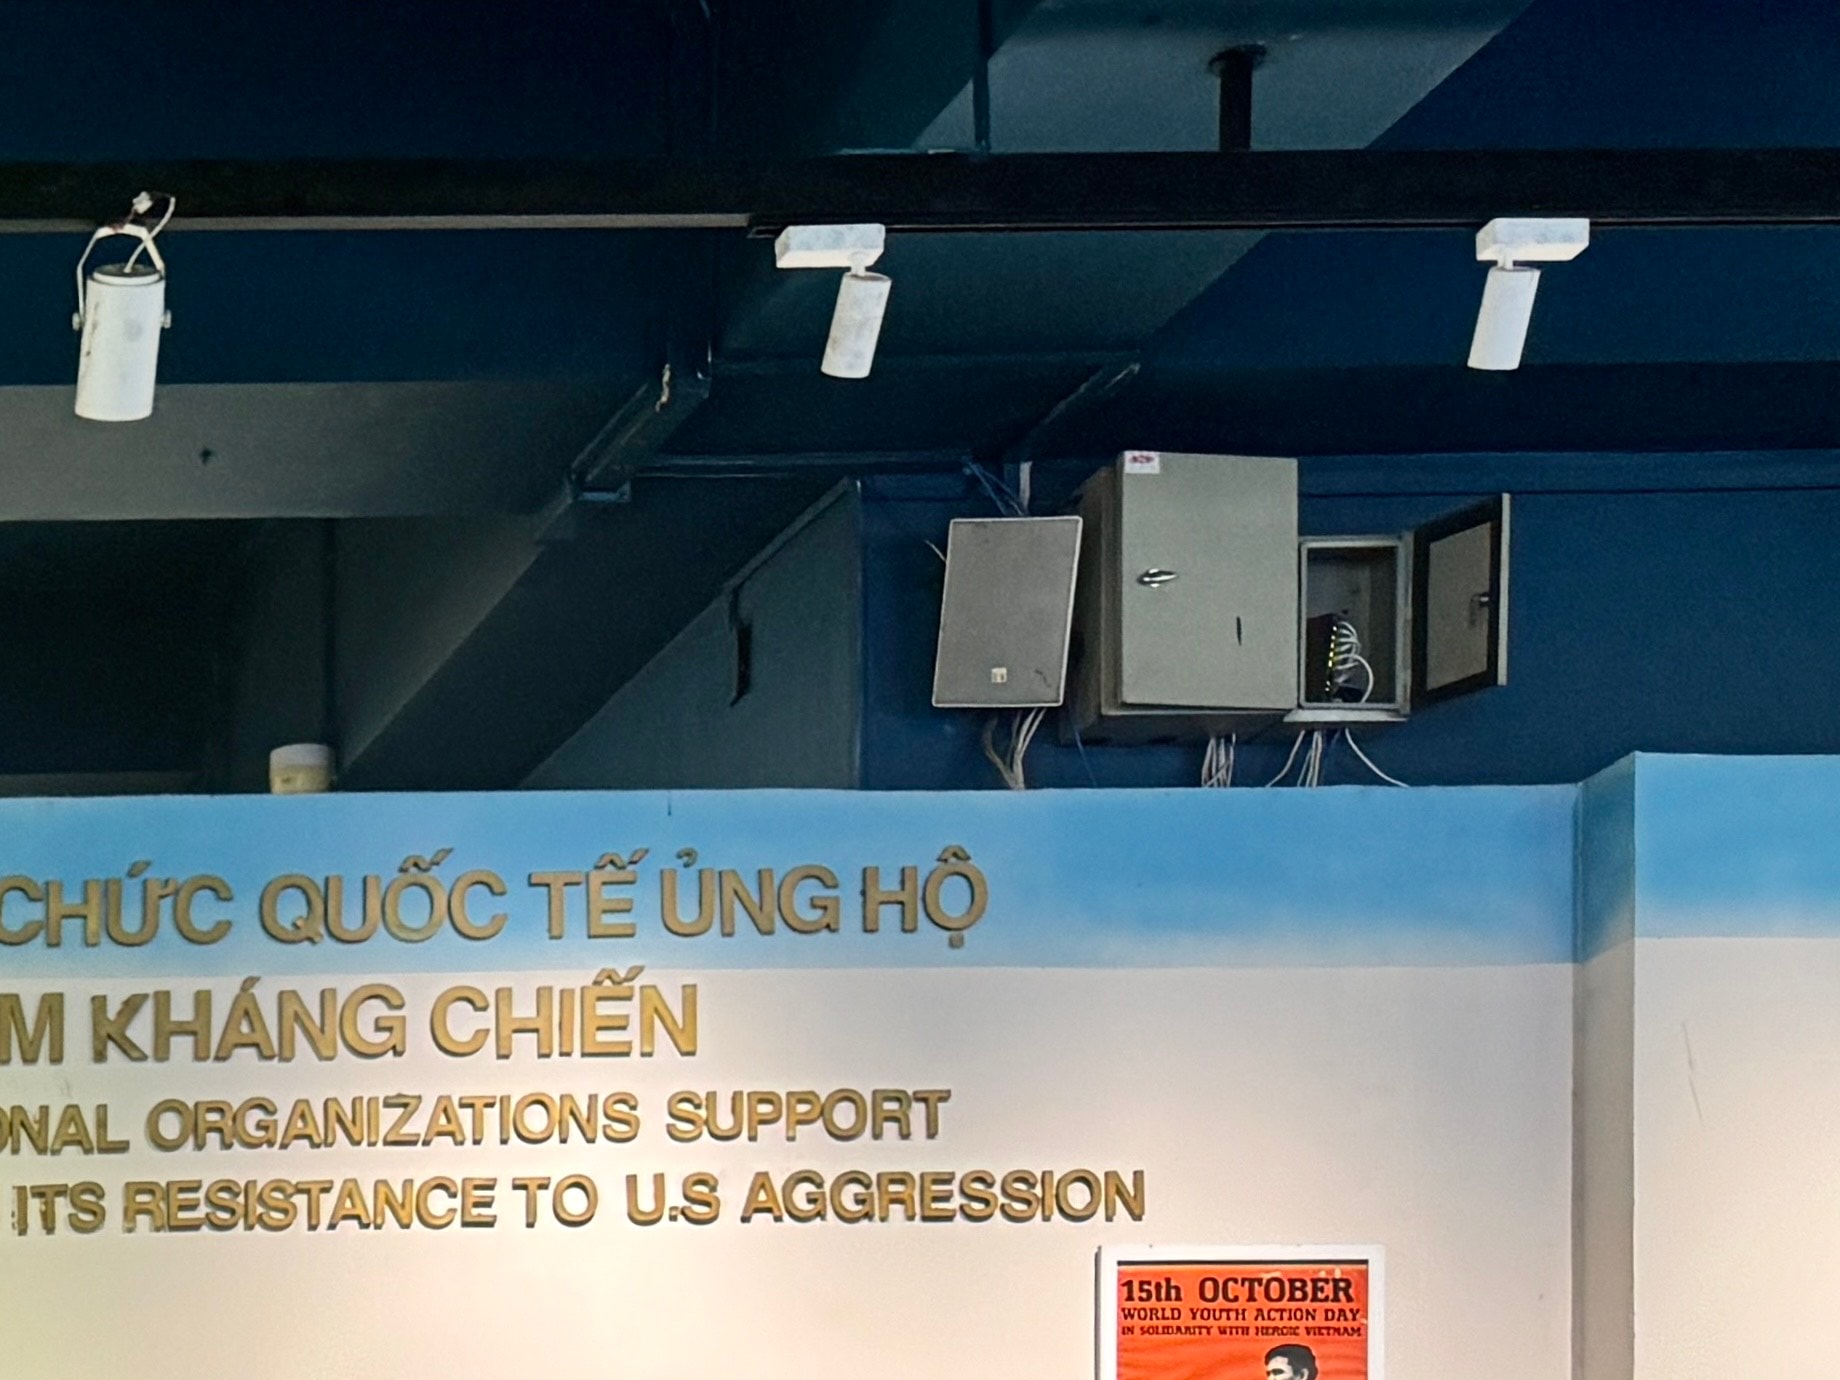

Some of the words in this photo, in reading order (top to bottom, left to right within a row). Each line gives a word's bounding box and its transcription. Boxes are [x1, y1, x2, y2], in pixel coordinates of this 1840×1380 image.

[259, 847, 507, 944] QUỐC
[527, 847, 649, 940] TẾ
[659, 848, 840, 938] ỦNG
[860, 845, 989, 949] HỘ
[90, 976, 407, 1065] KHÁNG
[429, 965, 699, 1060] CHIẾN
[146, 1091, 641, 1152] ORGANIZATIONS
[665, 1088, 952, 1143] SUPPORT
[20, 1181, 106, 1236] ITS
[123, 1177, 498, 1236] RESISTANCE
[512, 1174, 599, 1228] TO
[626, 1172, 720, 1227] U.S
[740, 1168, 1147, 1224] AGGRESSION
[1121, 1277, 1182, 1303] 15th
[1198, 1277, 1353, 1303] OCTOBER
[1121, 1307, 1182, 1321] WORLD
[1189, 1307, 1247, 1322] YOUTH
[1254, 1308, 1316, 1321] ACTION
[1324, 1308, 1360, 1322] DAY
[1121, 1326, 1134, 1335] IN
[1140, 1325, 1213, 1336] SOLIDARITY
[1217, 1325, 1250, 1336] WITH
[1305, 1326, 1362, 1337] VIETNAM
